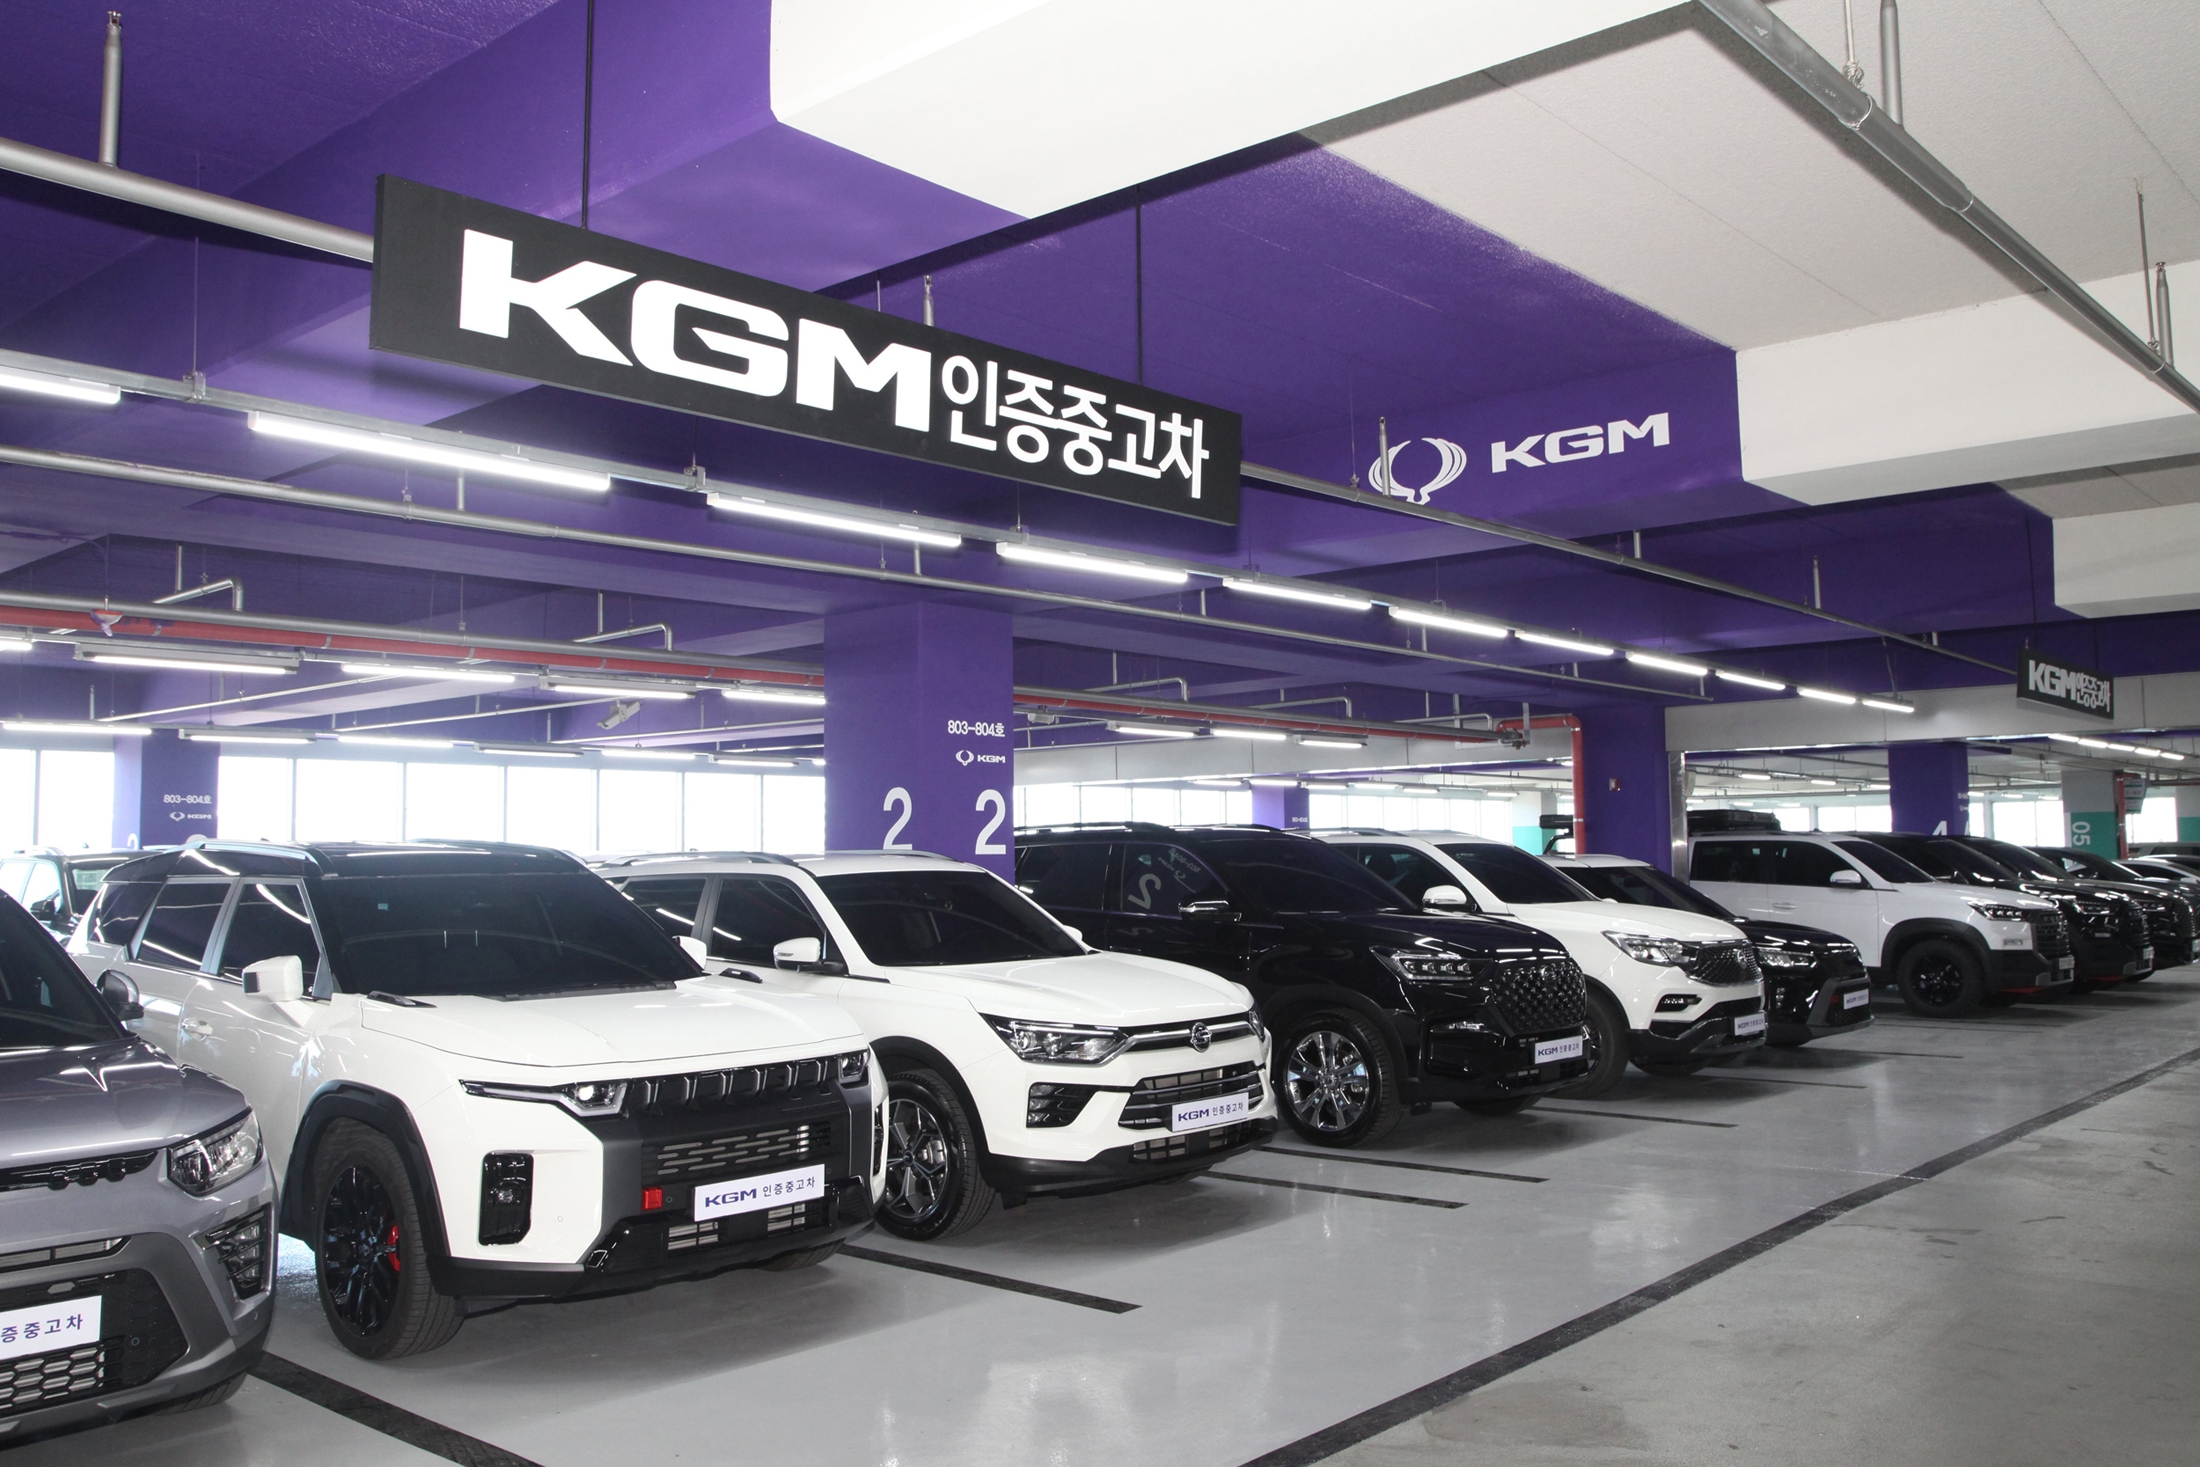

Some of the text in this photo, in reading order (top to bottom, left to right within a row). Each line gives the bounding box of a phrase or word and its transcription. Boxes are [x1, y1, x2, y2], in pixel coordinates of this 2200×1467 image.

[459, 228, 1210, 499] KGM 인증중고차
[1490, 411, 1671, 474] KGM
[2028, 659, 2076, 701] KGM
[947, 719, 1006, 738] 803-804호
[977, 754, 1006, 763] KGM
[882, 786, 913, 850] 2
[974, 788, 1007, 855] 2
[1537, 1047, 1559, 1056] KGM
[1178, 1101, 1243, 1122] KGM 인증중고차
[705, 1176, 816, 1207] KGM 인증중고차
[0, 1314, 83, 1343] 증중고차
